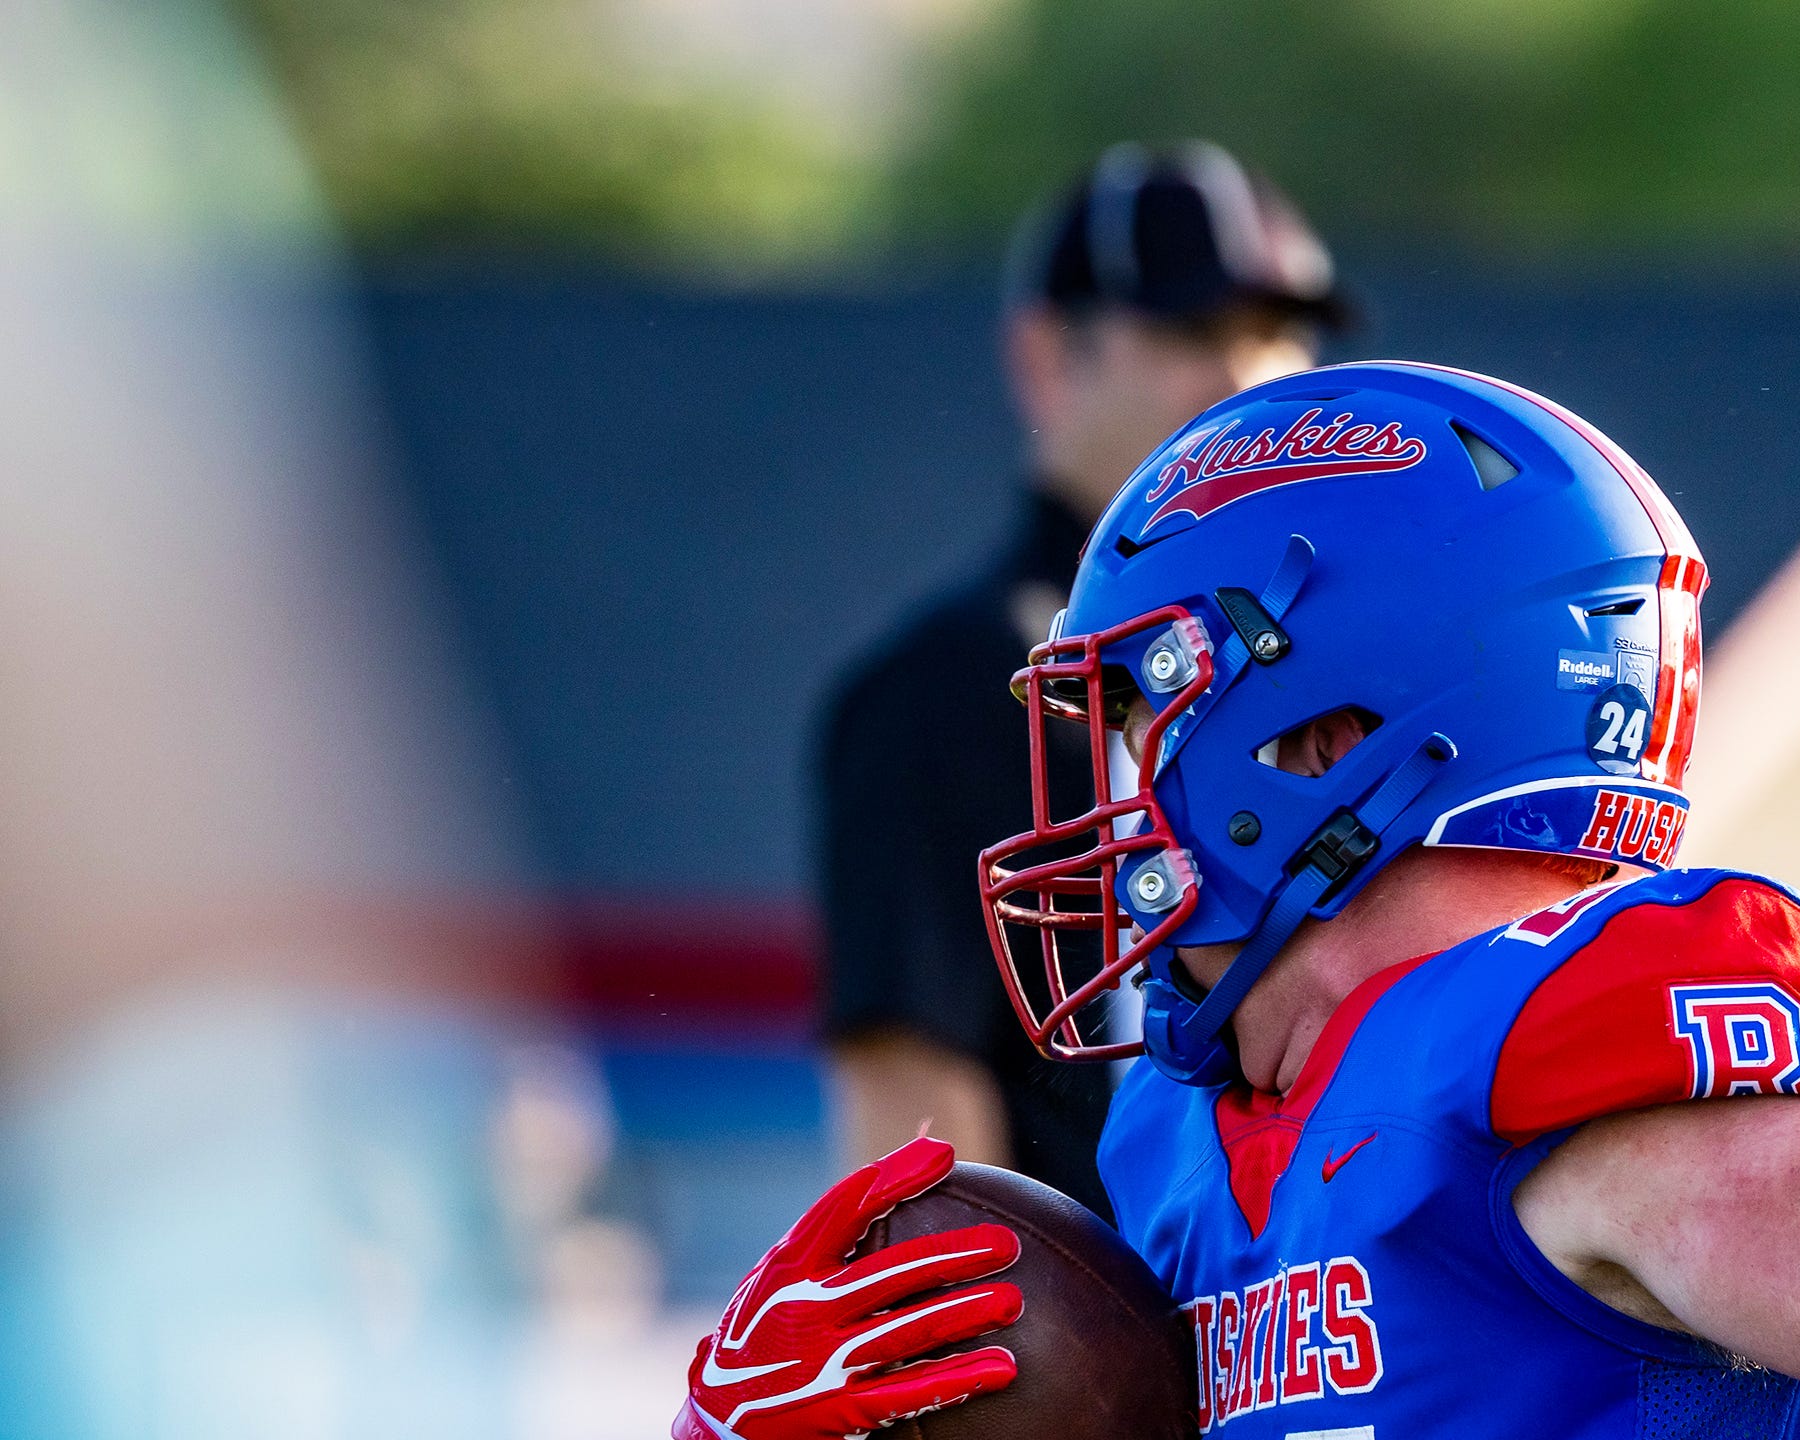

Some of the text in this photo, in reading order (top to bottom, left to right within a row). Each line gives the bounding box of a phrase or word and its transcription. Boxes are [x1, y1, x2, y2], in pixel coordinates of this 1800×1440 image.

[1146, 408, 1426, 503] Huskies
[1559, 658, 1611, 678] Riddell
[1574, 676, 1599, 686] LARGE
[1593, 701, 1647, 760] 24
[1178, 1255, 1384, 1434] USKIES
